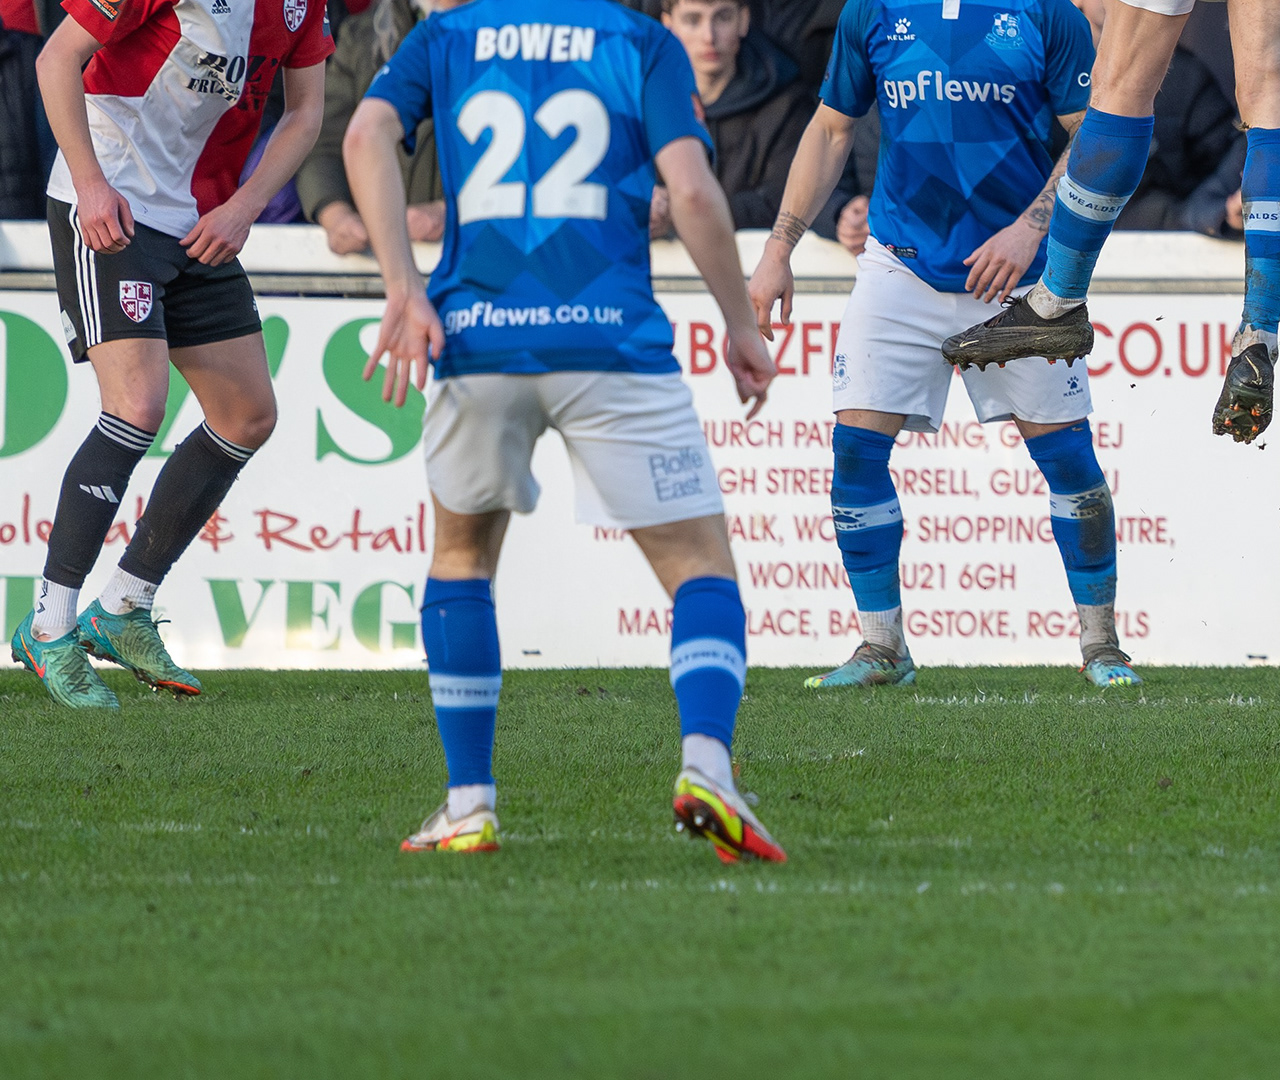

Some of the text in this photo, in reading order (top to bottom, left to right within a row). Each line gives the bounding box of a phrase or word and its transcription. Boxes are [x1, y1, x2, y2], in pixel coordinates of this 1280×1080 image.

[475, 23, 596, 62] BOWEN
[886, 33, 916, 41] KELME
[883, 70, 1016, 109] gpflewis
[456, 88, 611, 226] 22
[254, 503, 427, 554] Retail
[958, 563, 1017, 590] 6GH
[203, 576, 418, 654] VEG
